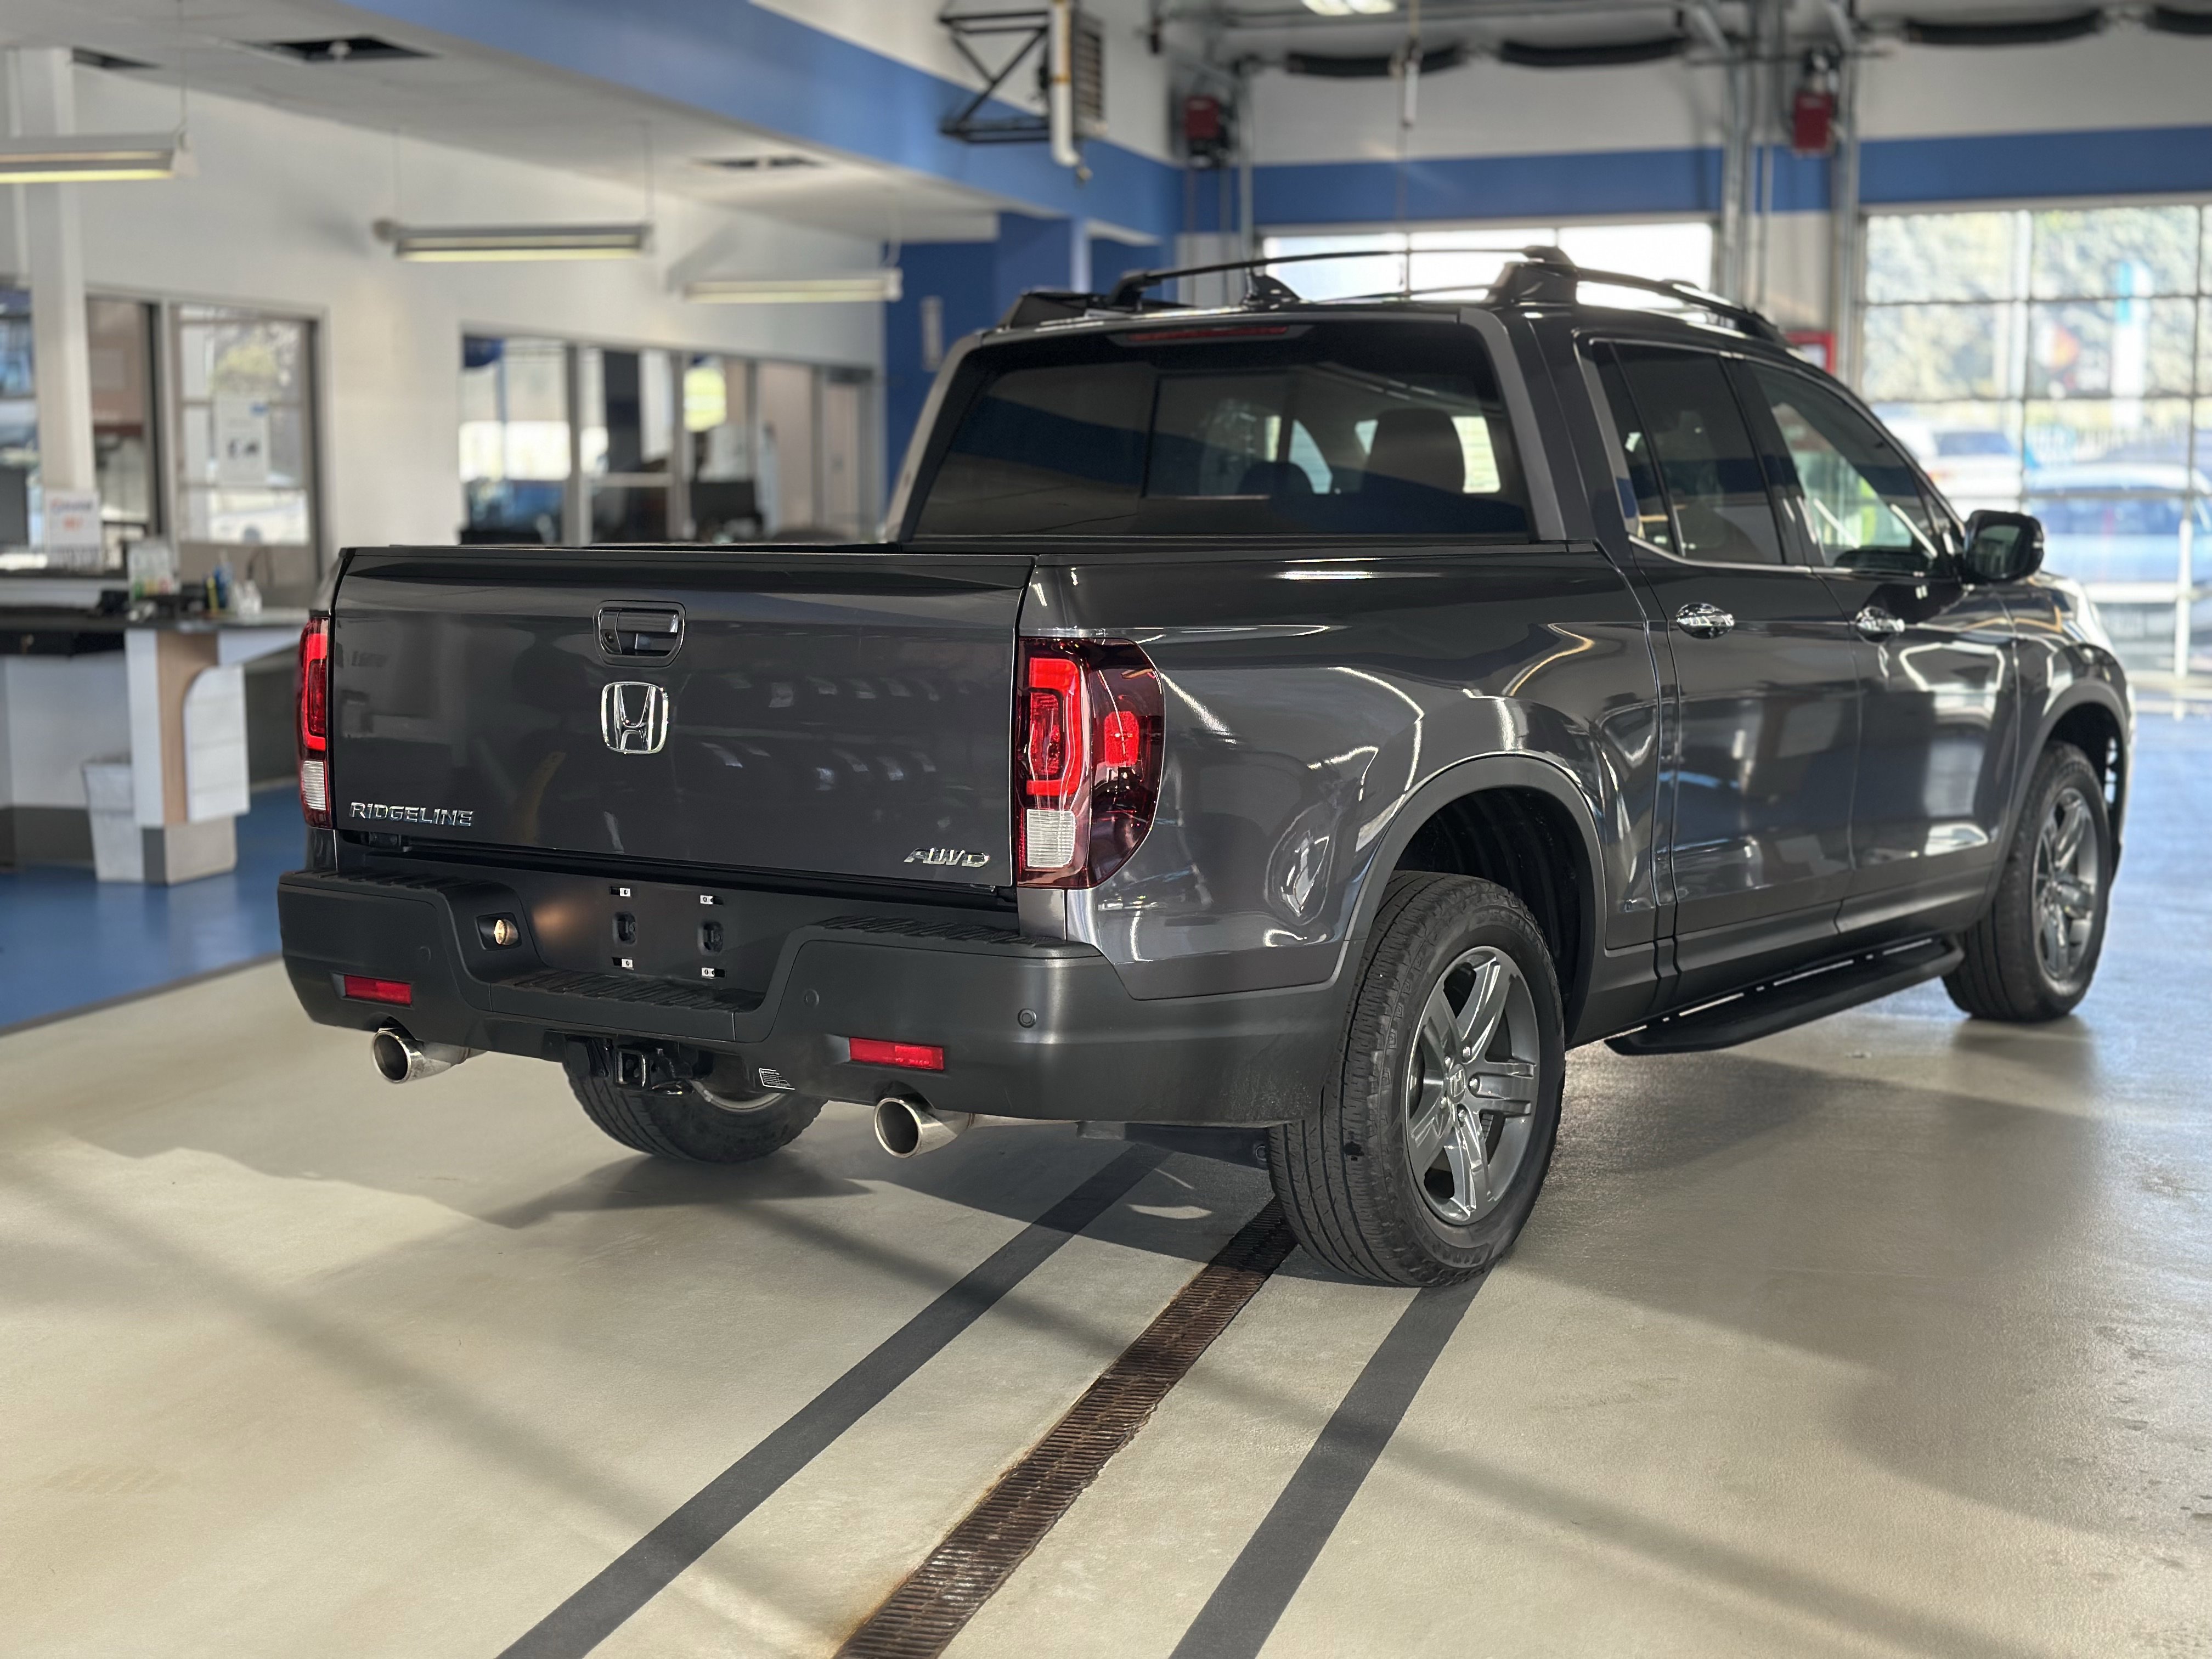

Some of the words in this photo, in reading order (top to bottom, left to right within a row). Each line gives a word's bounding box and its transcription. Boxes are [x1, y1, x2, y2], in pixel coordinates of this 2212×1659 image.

[610, 682, 659, 752] H
[348, 802, 474, 827] RIDGELINE
[904, 848, 990, 868] AWD
